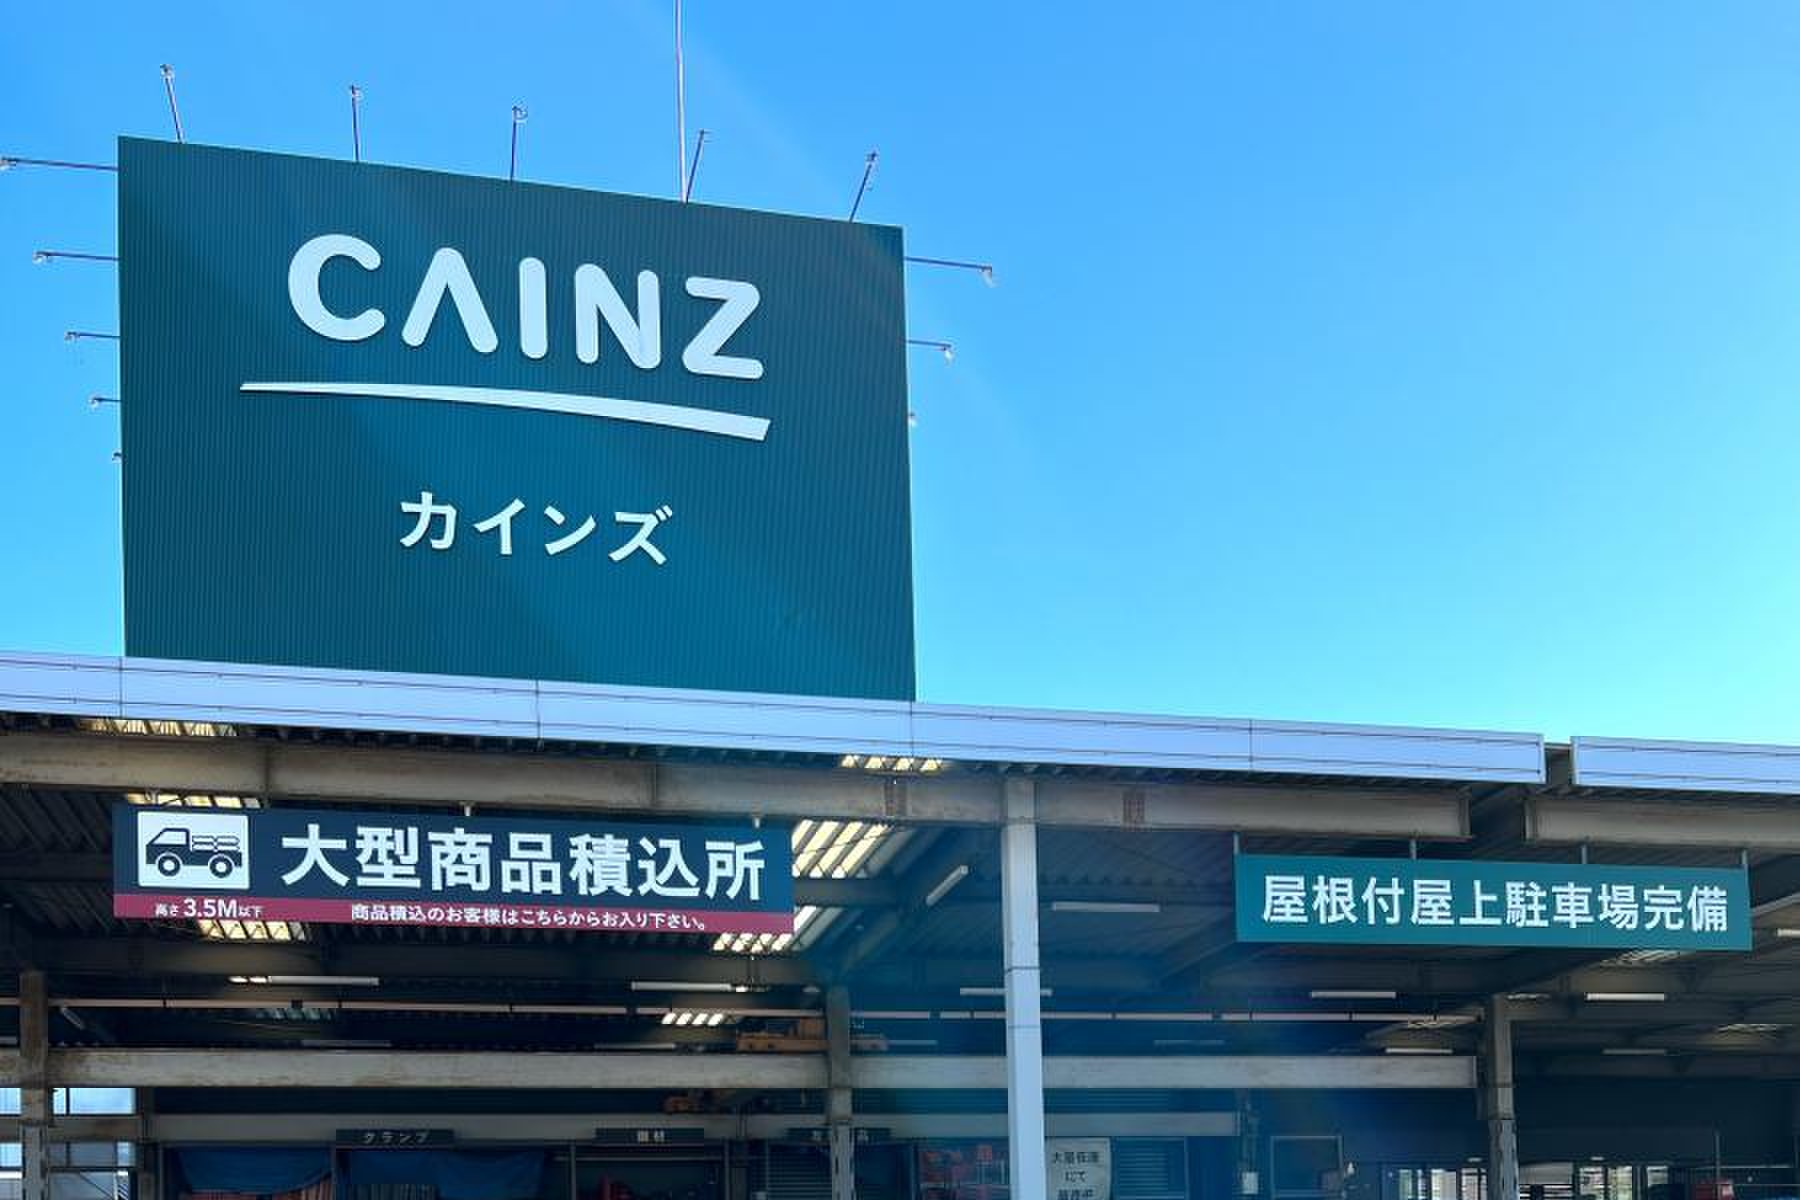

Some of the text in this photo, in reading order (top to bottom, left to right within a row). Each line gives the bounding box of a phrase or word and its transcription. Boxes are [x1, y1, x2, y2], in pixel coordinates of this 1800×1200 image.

[287, 234, 764, 380] CAINZ
[399, 491, 673, 566] カインズ
[280, 822, 766, 901] 大型商品積込所
[350, 903, 706, 931] 商品積込のお客様はこちらからお入り下さい。
[1262, 875, 1729, 933] 屋根付屋上駐車場完備
